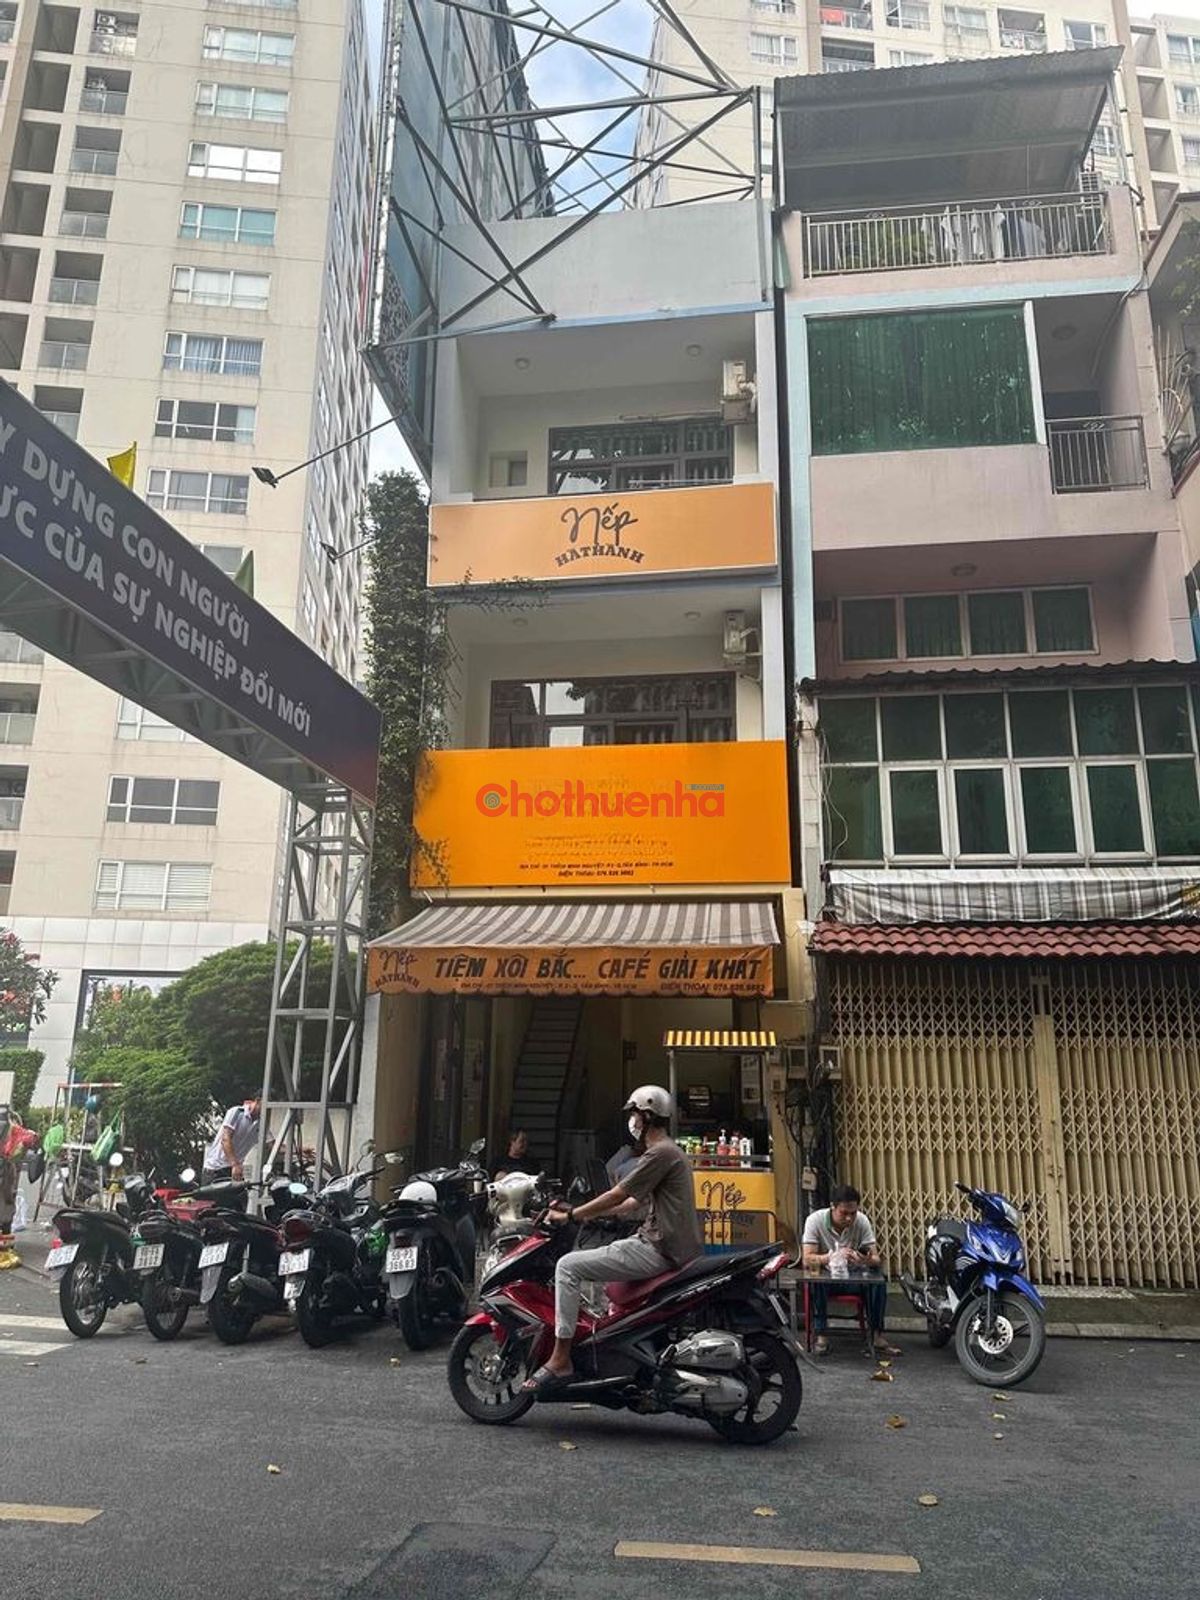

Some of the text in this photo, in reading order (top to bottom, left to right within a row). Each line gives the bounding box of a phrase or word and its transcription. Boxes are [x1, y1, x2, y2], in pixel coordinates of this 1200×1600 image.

[23, 438, 115, 539] DỰNG
[122, 525, 174, 587] CON
[179, 569, 249, 646] NGƯỜI
[45, 522, 104, 591] CỦA
[113, 571, 151, 623] SỰ
[155, 602, 237, 681] NGHIỆP
[240, 668, 274, 710] ĐỔI
[278, 693, 311, 737] MỚI
[434, 953, 487, 982] TIỆM
[493, 953, 529, 978] XÔI
[598, 950, 651, 979] CAFÉ
[659, 950, 698, 979] GIẢI
[705, 951, 762, 979] KHÁT
